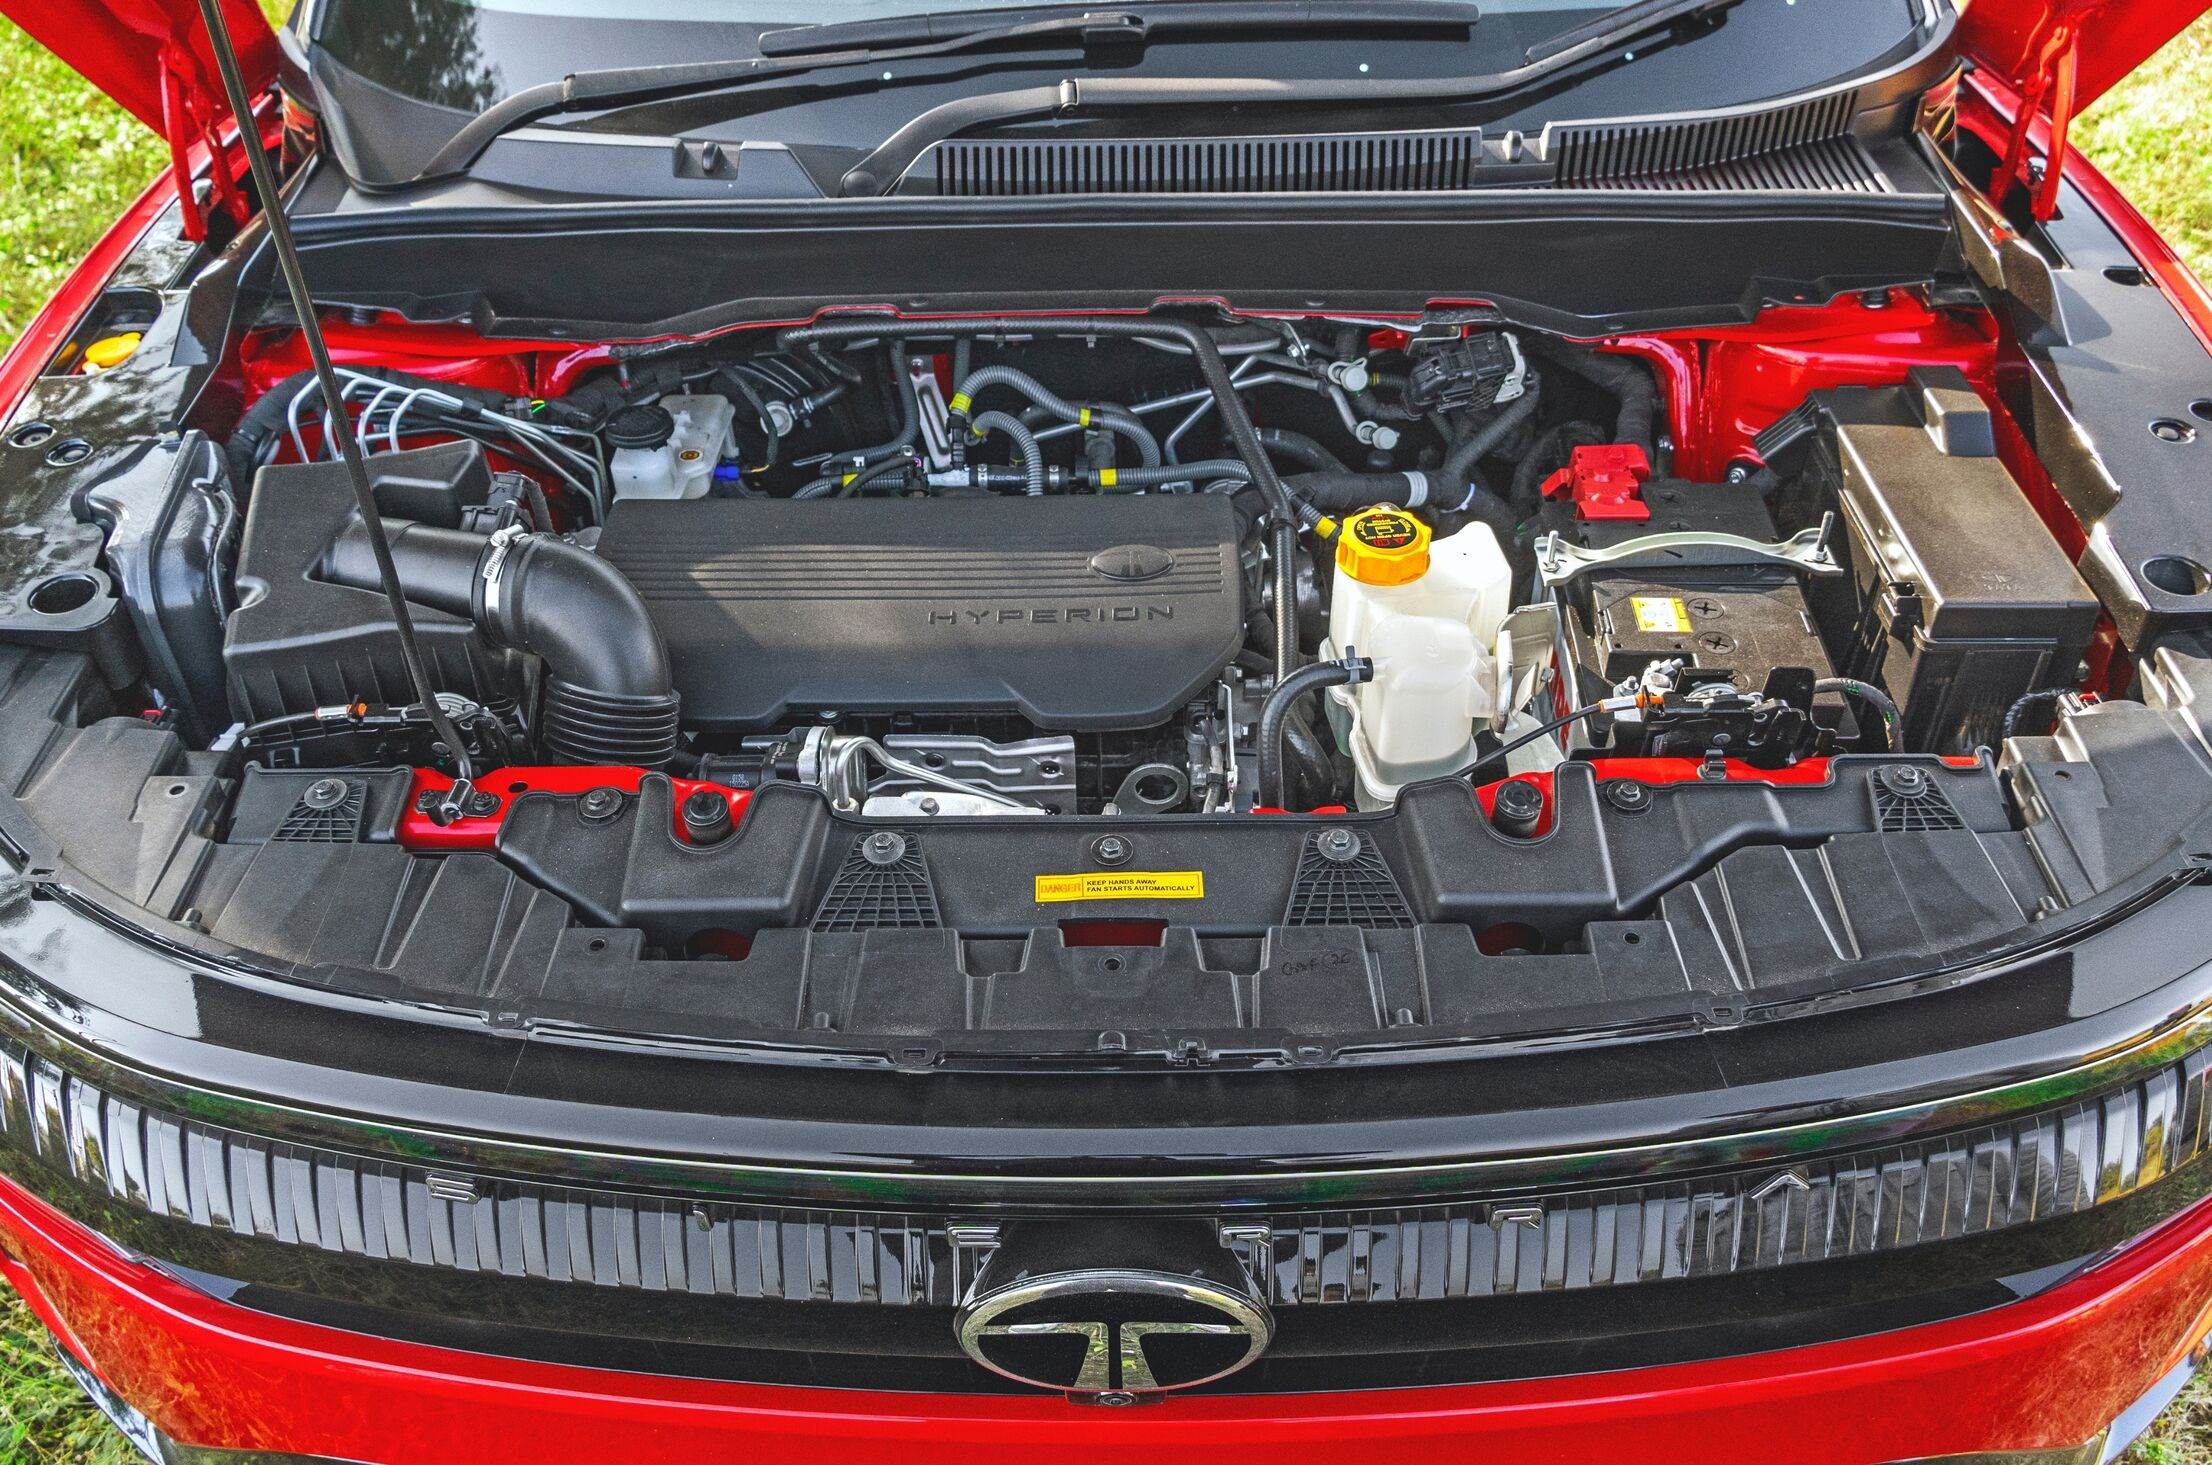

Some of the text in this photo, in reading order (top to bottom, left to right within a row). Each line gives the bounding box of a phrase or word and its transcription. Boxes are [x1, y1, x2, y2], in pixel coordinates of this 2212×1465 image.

[928, 604, 1175, 625] HYPERION
[1040, 883, 1082, 894] DANGER
[1133, 884, 1196, 892] AUTOMATICALLY
